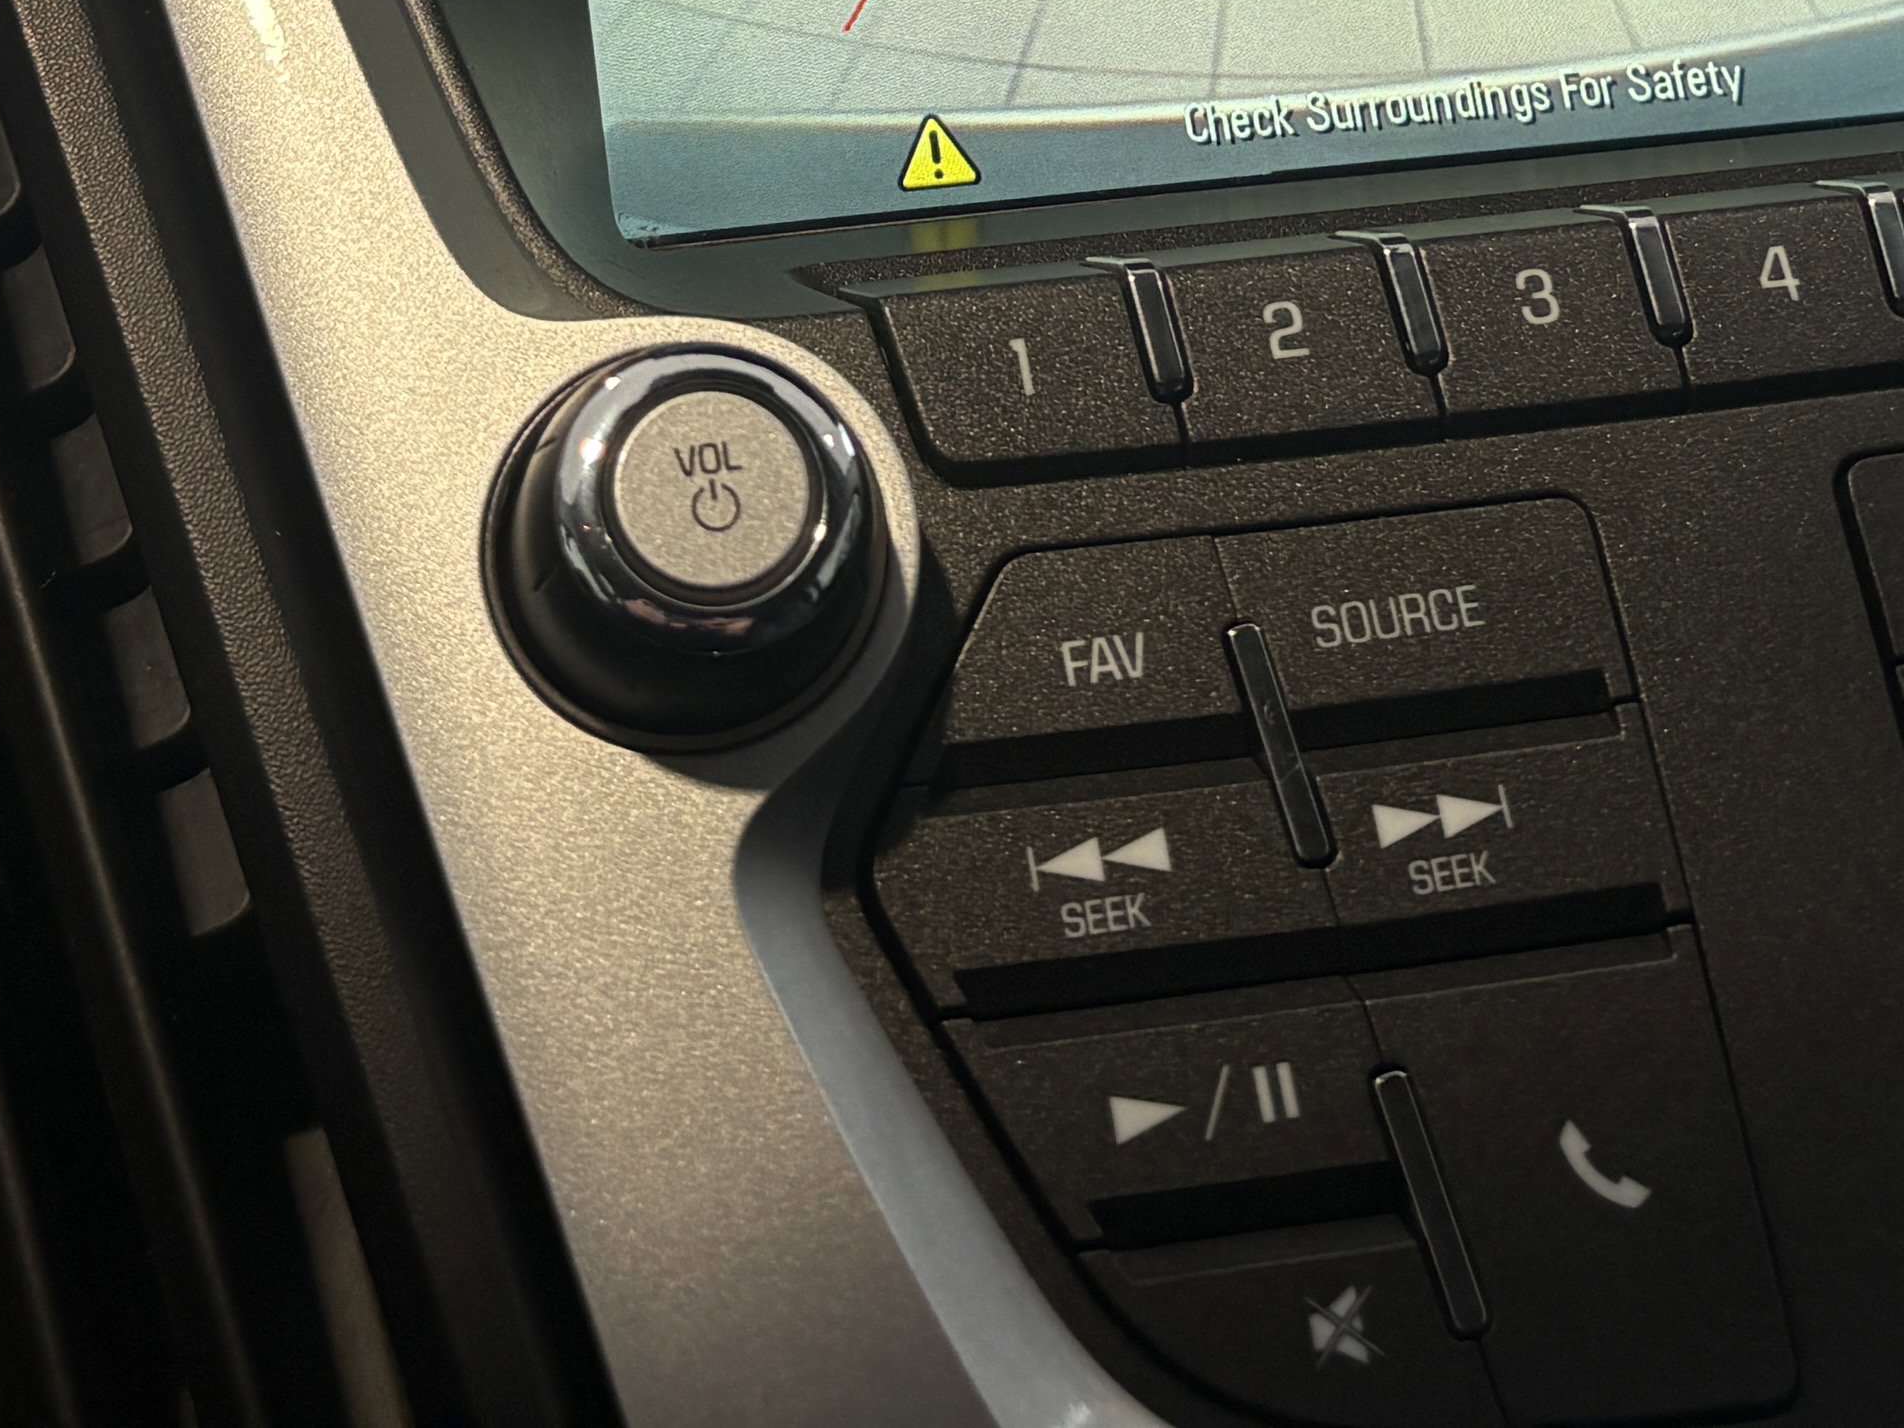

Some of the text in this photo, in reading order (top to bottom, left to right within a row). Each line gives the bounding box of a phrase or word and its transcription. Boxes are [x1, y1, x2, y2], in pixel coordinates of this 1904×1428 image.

[1185, 58, 1742, 144] Check Surroundings For Safety
[1515, 268, 1560, 325] 3
[1759, 245, 1801, 301] 4
[1262, 301, 1310, 360] 2
[1009, 338, 1035, 396] 1
[674, 441, 743, 478] VOL
[1310, 584, 1485, 649] SOURCE
[1060, 632, 1146, 686] FAV
[1407, 850, 1496, 895] SEEK
[1060, 893, 1151, 939] SEEK
